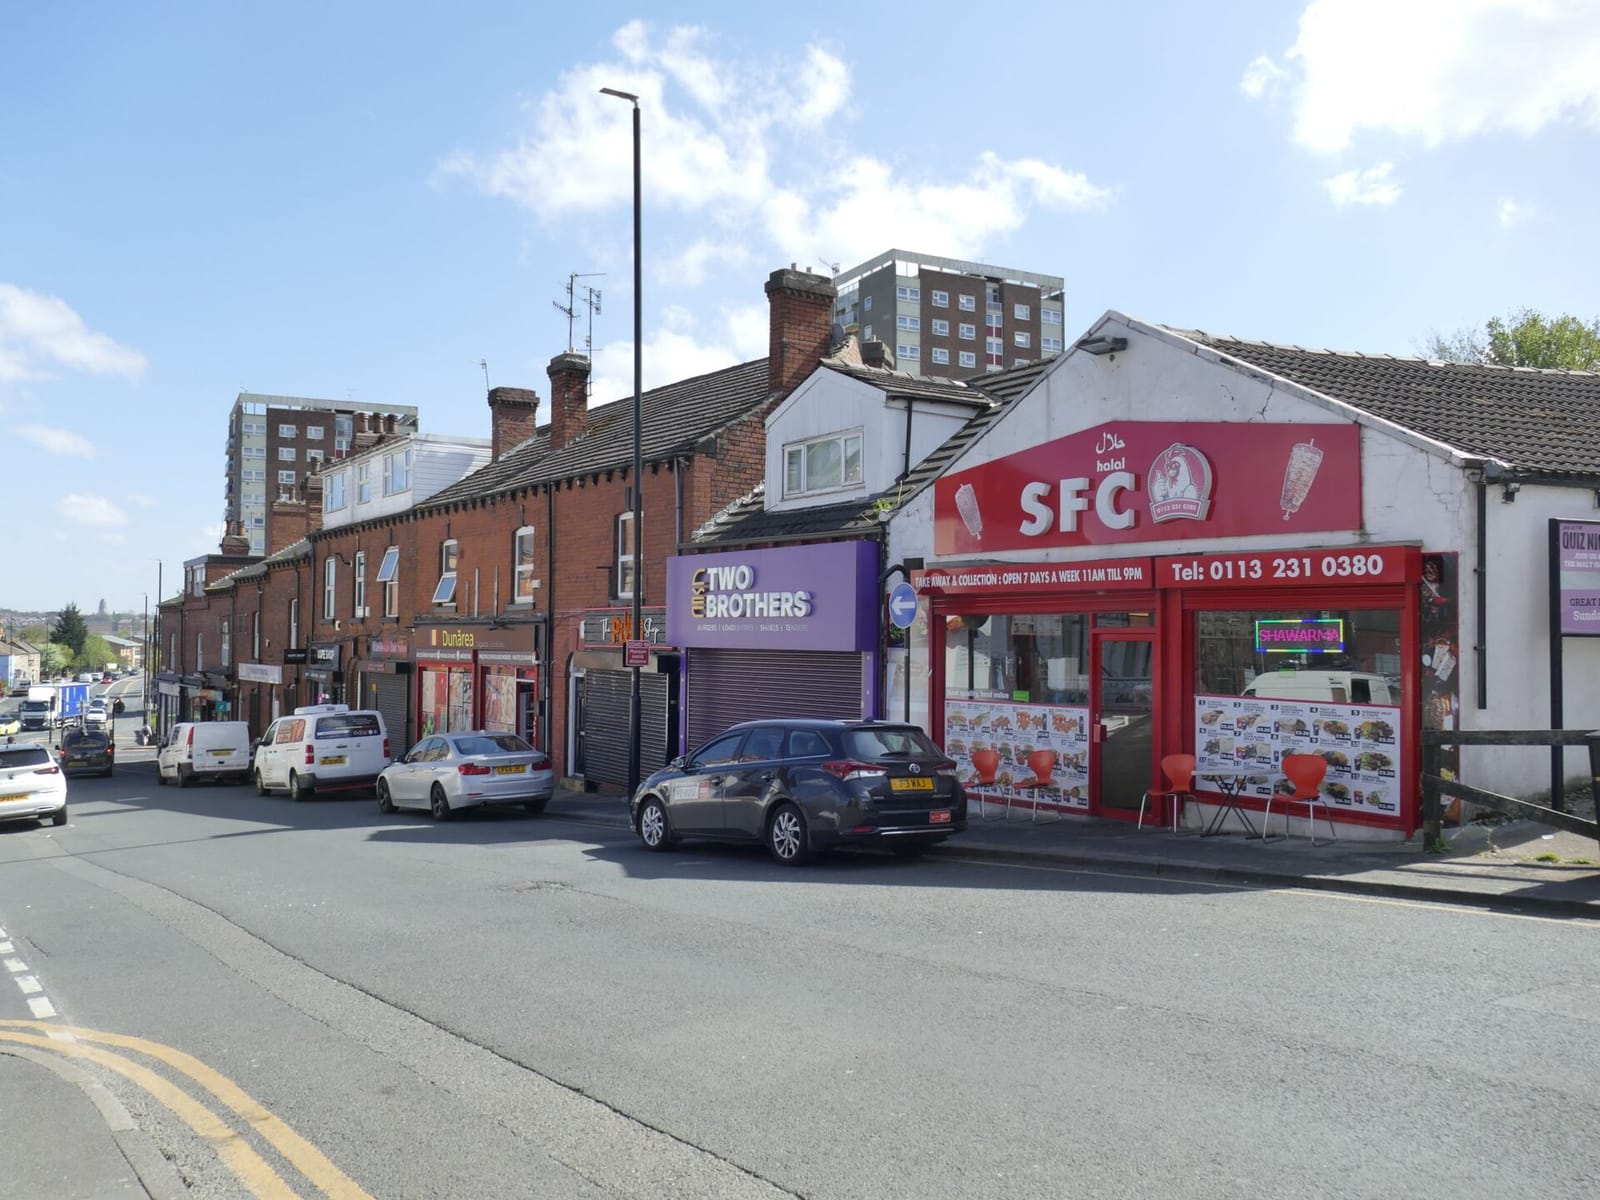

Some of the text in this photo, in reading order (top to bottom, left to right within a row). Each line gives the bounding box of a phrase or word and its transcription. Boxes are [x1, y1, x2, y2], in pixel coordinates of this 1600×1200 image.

[1096, 432, 1126, 454] حلال
[1097, 457, 1125, 472] halal
[1020, 471, 1136, 536] SFC
[1562, 532, 1585, 550] QUIZ
[707, 565, 754, 591] TWO
[915, 575, 931, 588] TAKE
[931, 574, 951, 588] AWAY
[951, 574, 958, 587] &
[958, 573, 997, 586] COLLECTION
[1002, 572, 1022, 585] OPEN
[1023, 572, 1029, 584] 7
[1030, 571, 1050, 584] DAYS
[1051, 570, 1058, 583] A
[1059, 569, 1081, 583] WEEK
[1082, 568, 1105, 582] 11AM
[1107, 567, 1122, 581] TILL
[1123, 567, 1143, 580] 9PM
[1172, 554, 1384, 581] Tel: 0113 231 0380
[706, 590, 811, 618] BROTHERS
[1570, 598, 1597, 607] GREAT
[1259, 628, 1340, 642] SHAWARMA
